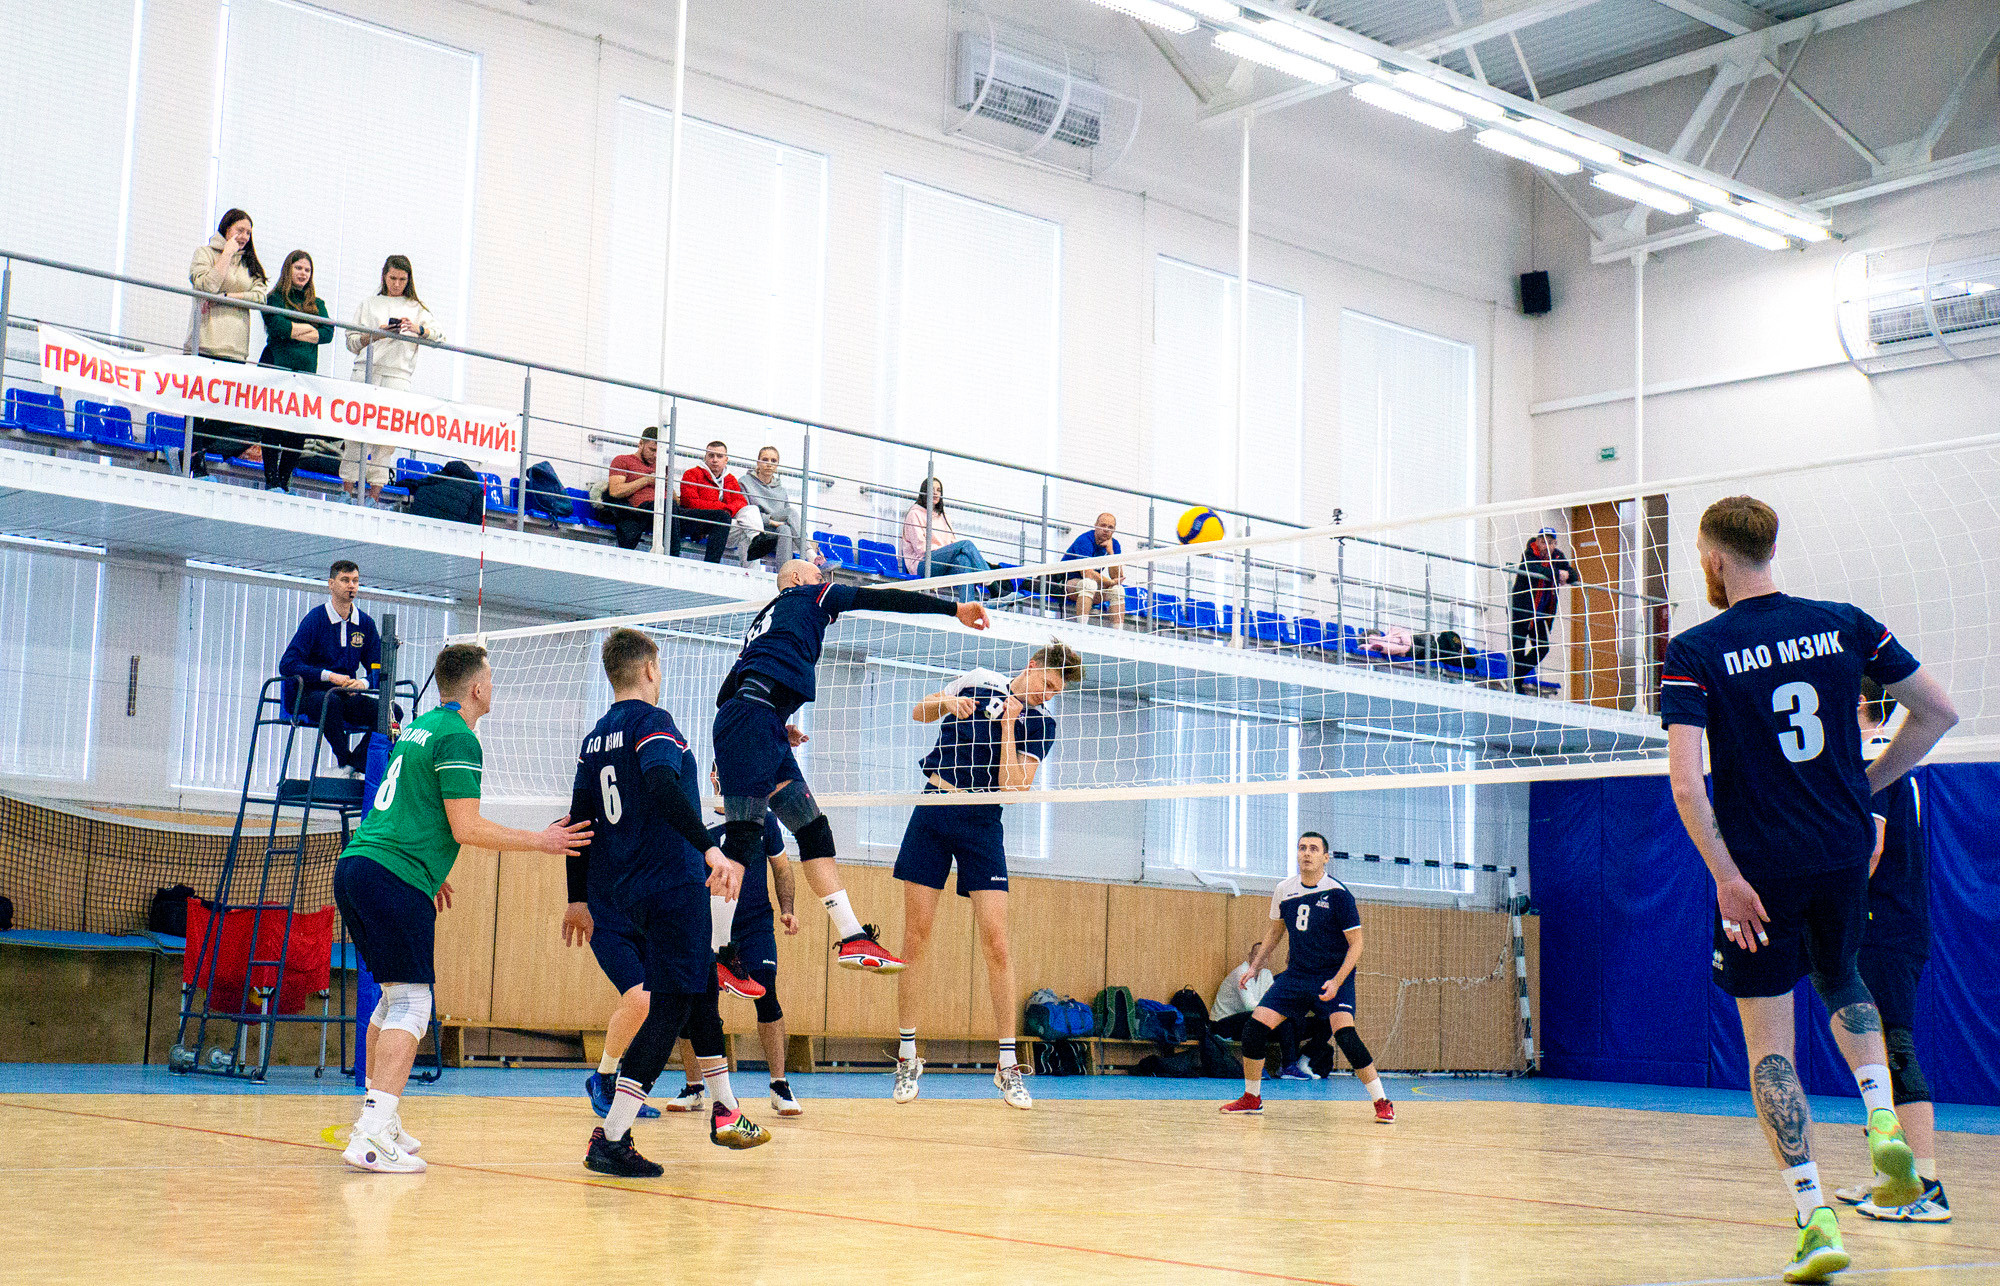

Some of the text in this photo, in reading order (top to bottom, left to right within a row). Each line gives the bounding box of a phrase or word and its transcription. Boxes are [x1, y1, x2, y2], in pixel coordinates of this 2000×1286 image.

[45, 344, 517, 453] ПРИВЕТ УЧАСТНИКАМ СОРЕВНОВАНИЙ!
[1723, 630, 1844, 675] ПАО МЗИК
[1771, 681, 1825, 763] 3
[373, 754, 404, 811] 8
[600, 764, 623, 825] 6
[1295, 903, 1311, 932] 8
